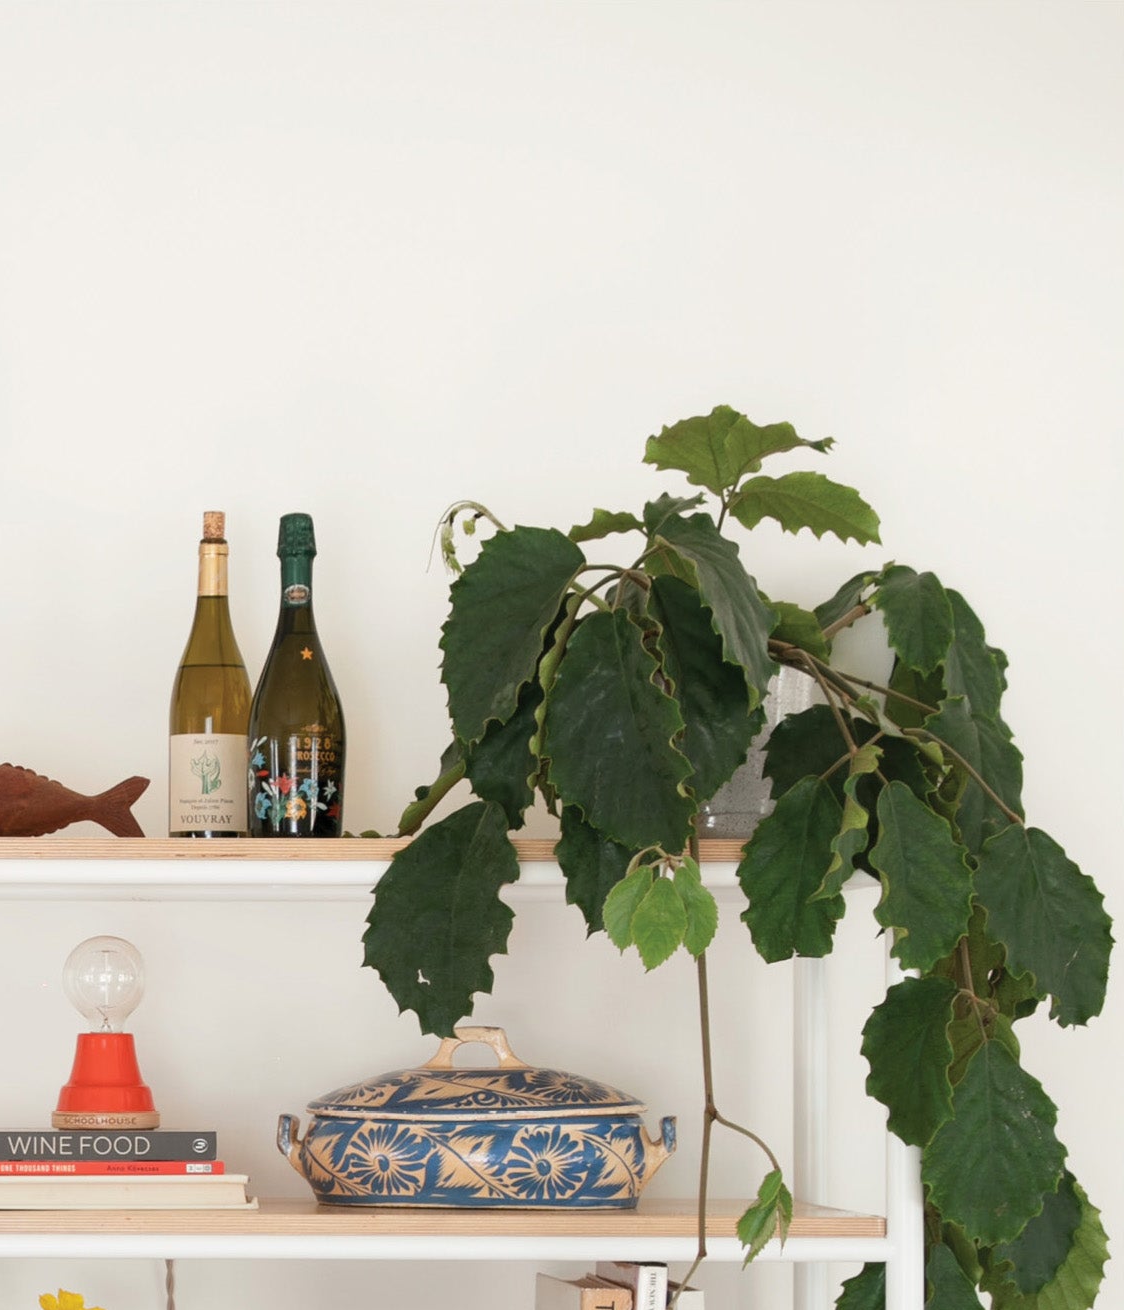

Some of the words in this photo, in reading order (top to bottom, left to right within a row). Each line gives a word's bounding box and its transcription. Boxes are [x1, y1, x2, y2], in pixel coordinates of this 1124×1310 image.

[180, 815, 233, 825] VOUVRAY
[63, 1116, 137, 1125] SCHOOLHOUSE
[7, 1136, 73, 1155] WINE
[79, 1136, 151, 1155] FOOD
[0, 1164, 13, 1172] ONE
[15, 1164, 50, 1172] THOUSAND
[52, 1164, 76, 1172] THINGS
